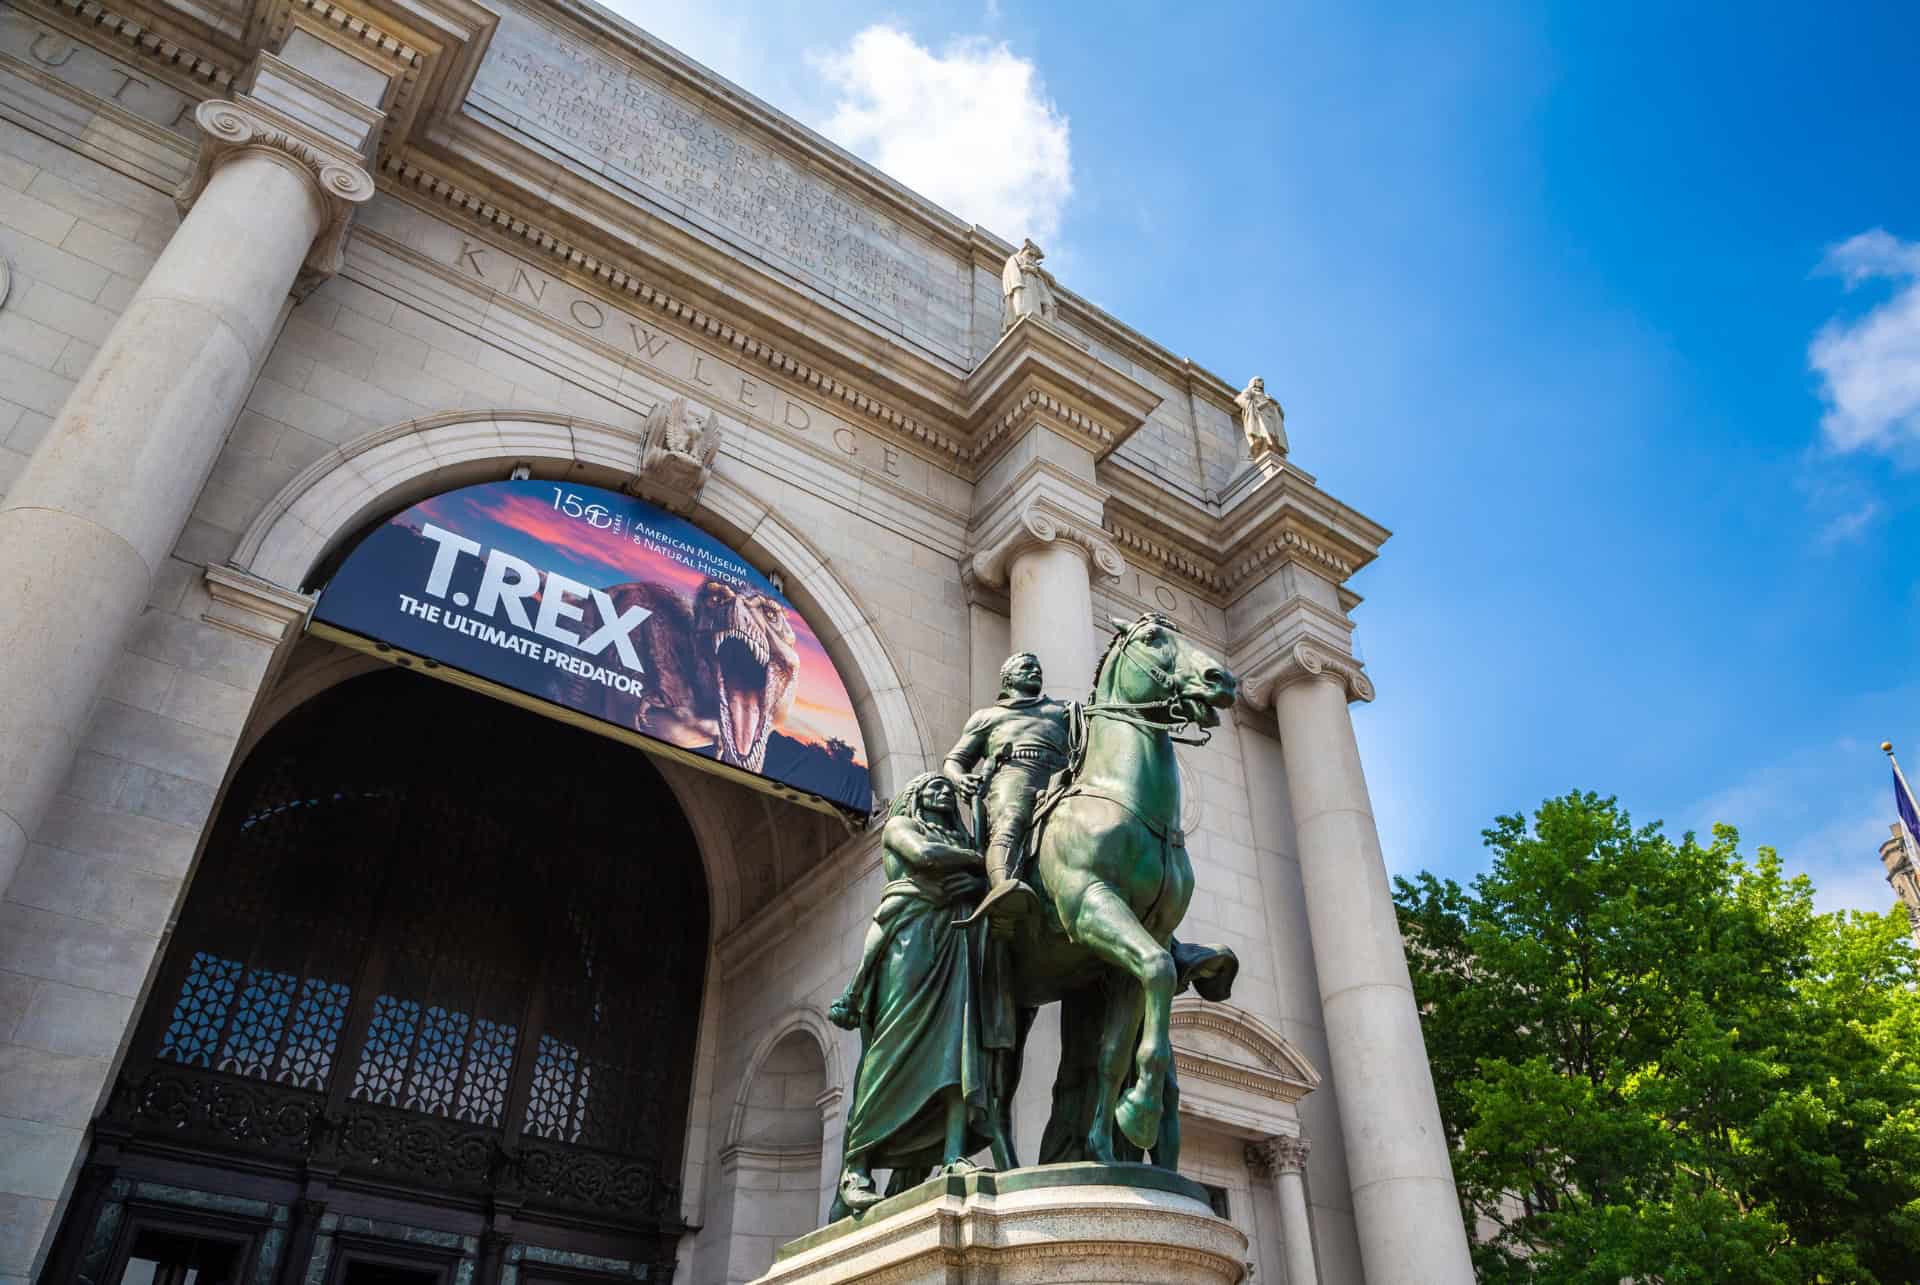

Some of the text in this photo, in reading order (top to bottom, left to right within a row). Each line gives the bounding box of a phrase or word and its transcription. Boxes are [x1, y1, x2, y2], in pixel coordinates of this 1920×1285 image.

[454, 239, 899, 477] KNOWLEDGE
[400, 594, 644, 698] THE ULTIMATE PREDATOR
[422, 522, 652, 674] T.REX
